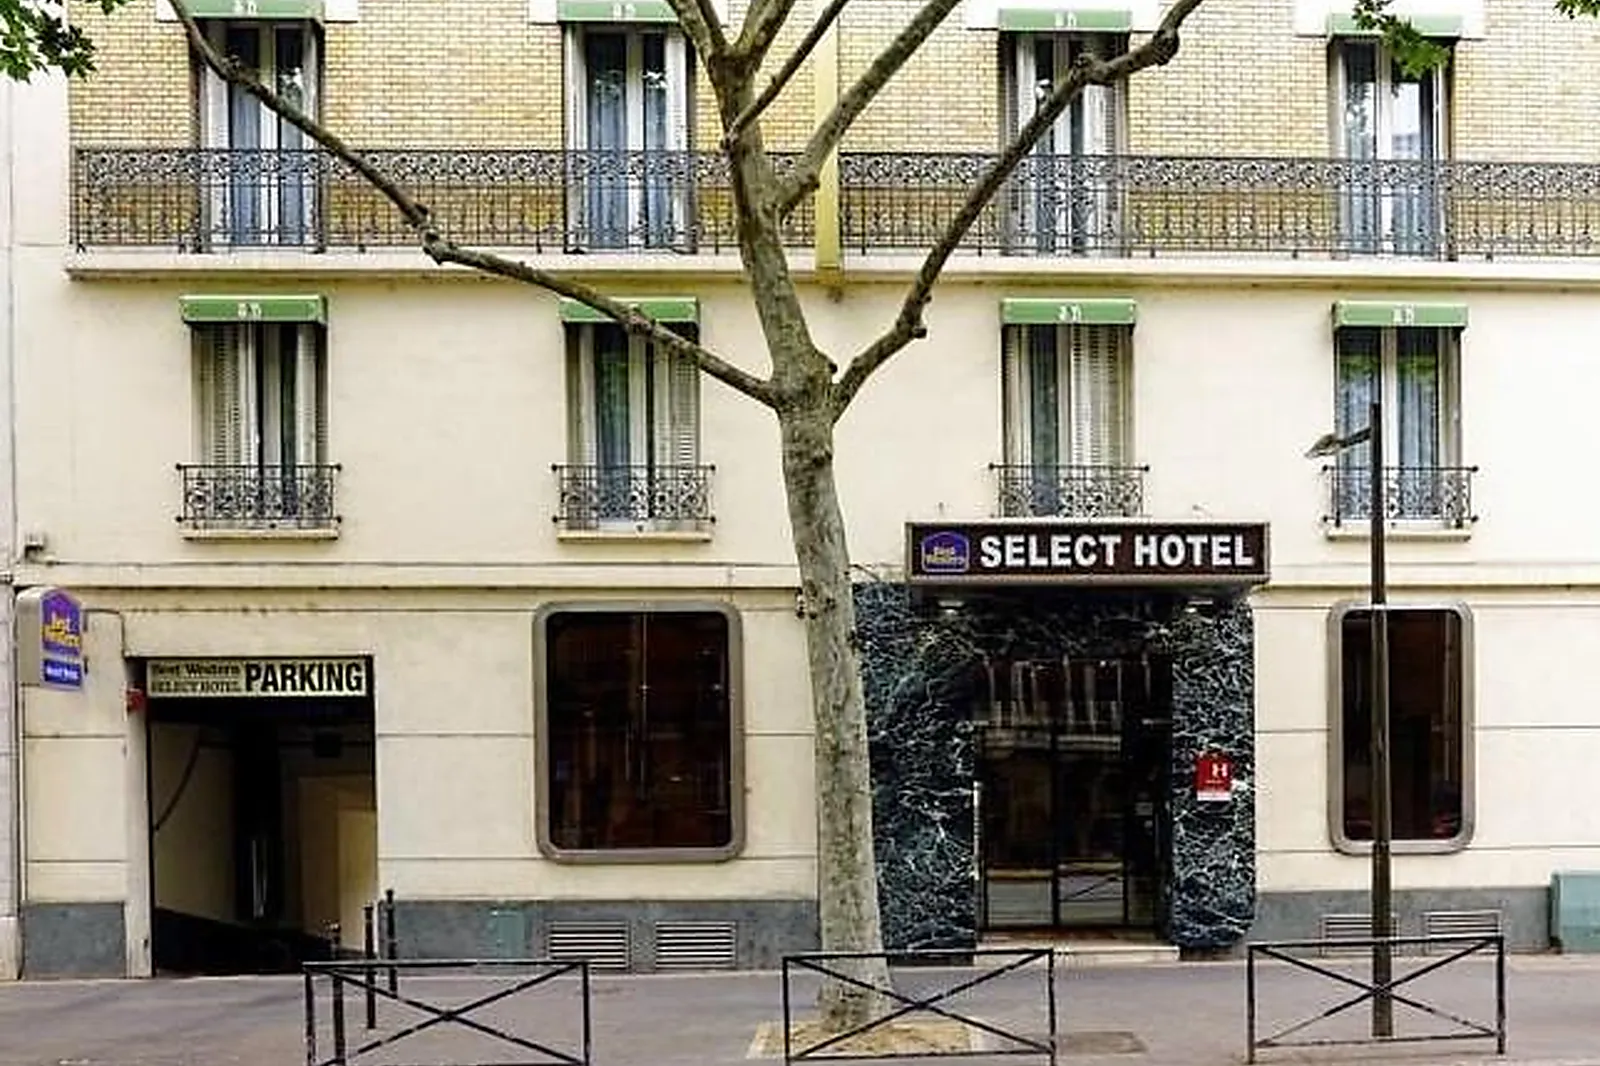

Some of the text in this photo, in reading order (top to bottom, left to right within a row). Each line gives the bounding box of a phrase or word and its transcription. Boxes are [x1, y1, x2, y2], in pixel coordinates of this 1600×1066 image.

[980, 534, 1122, 568] SELECT
[1134, 534, 1255, 567] HOTEL
[245, 663, 362, 692] PARKING
[1211, 762, 1229, 778] H
